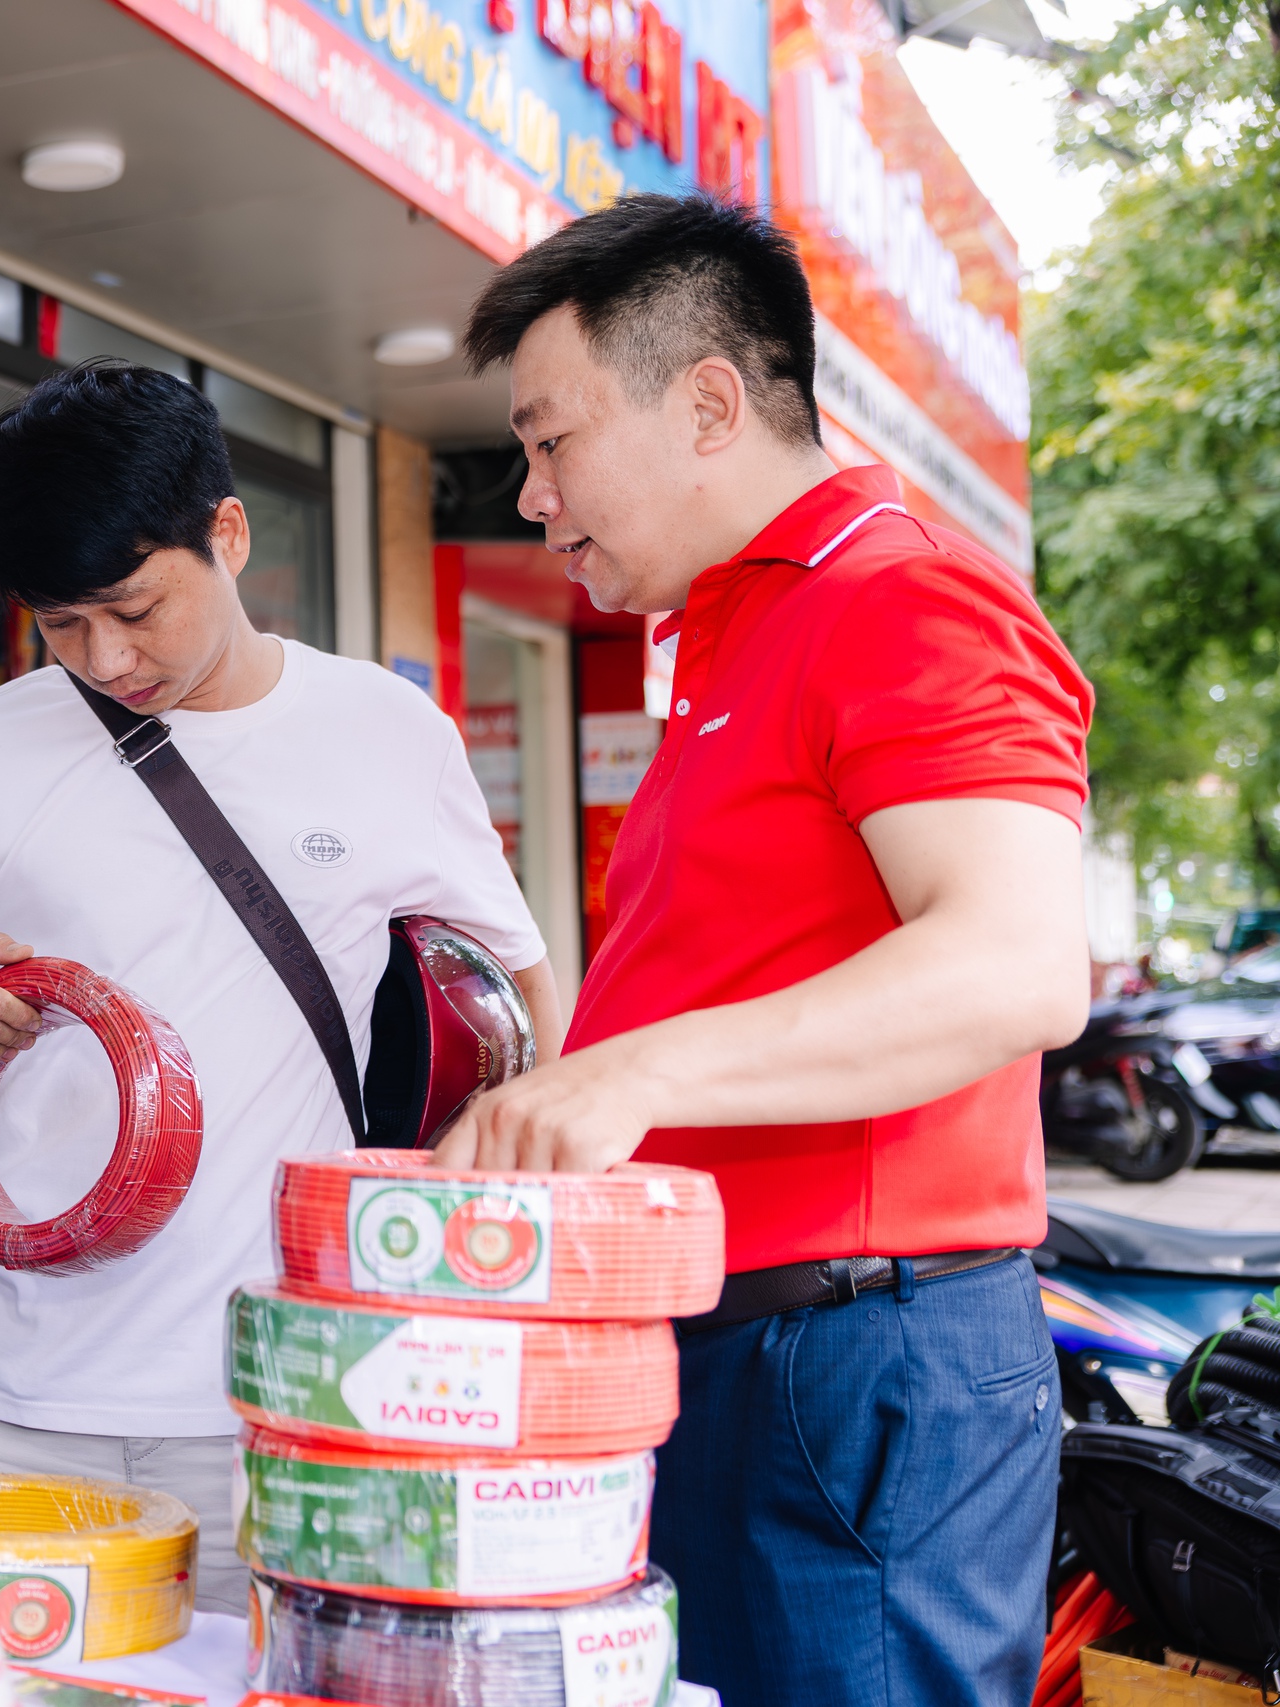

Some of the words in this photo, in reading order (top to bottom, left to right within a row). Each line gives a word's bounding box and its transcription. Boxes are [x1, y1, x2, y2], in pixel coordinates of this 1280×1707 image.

[476, 1036, 489, 1079] Royal
[381, 1401, 499, 1430] CADIVI
[475, 1476, 595, 1501] CADIVI
[577, 1623, 657, 1654] CADIVI
